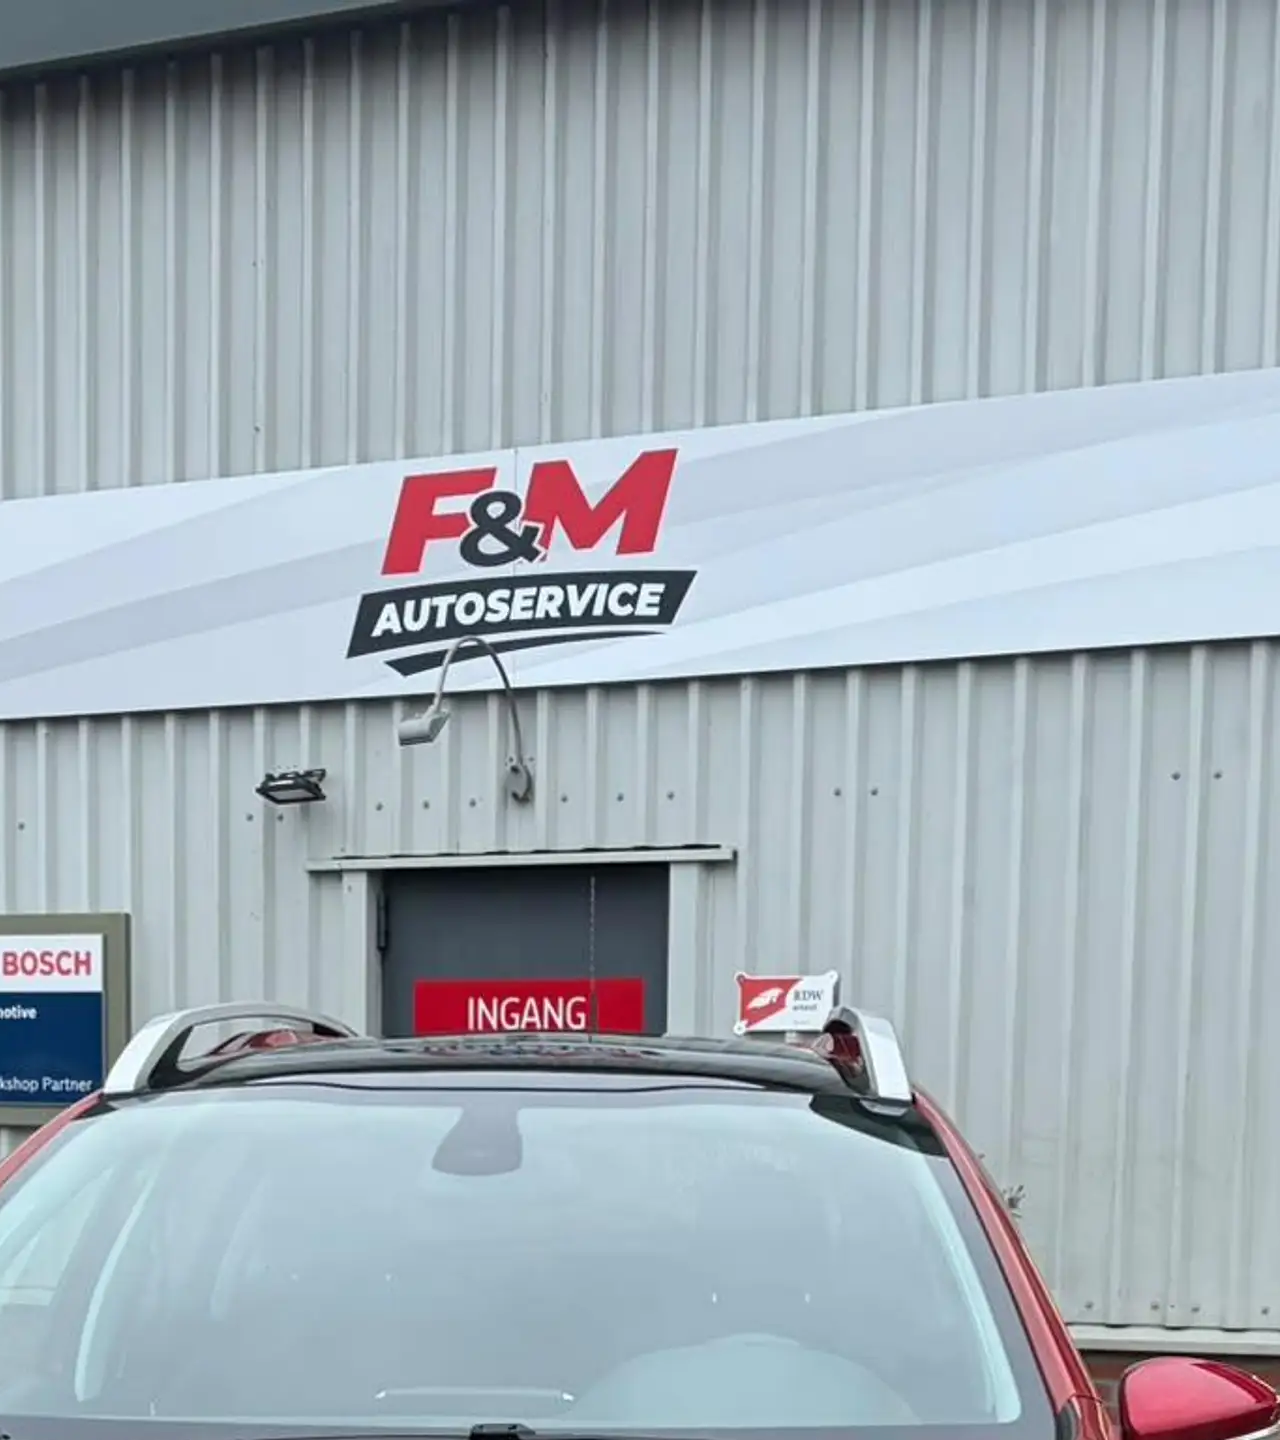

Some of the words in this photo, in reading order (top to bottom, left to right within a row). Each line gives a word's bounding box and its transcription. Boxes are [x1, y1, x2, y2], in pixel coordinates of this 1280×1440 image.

[380, 448, 679, 576] F&M
[370, 582, 666, 637] AUTOSERVICE
[2, 951, 92, 976] BOSCH
[467, 996, 587, 1031] INGANG
[42, 1075, 93, 1092] Partner
